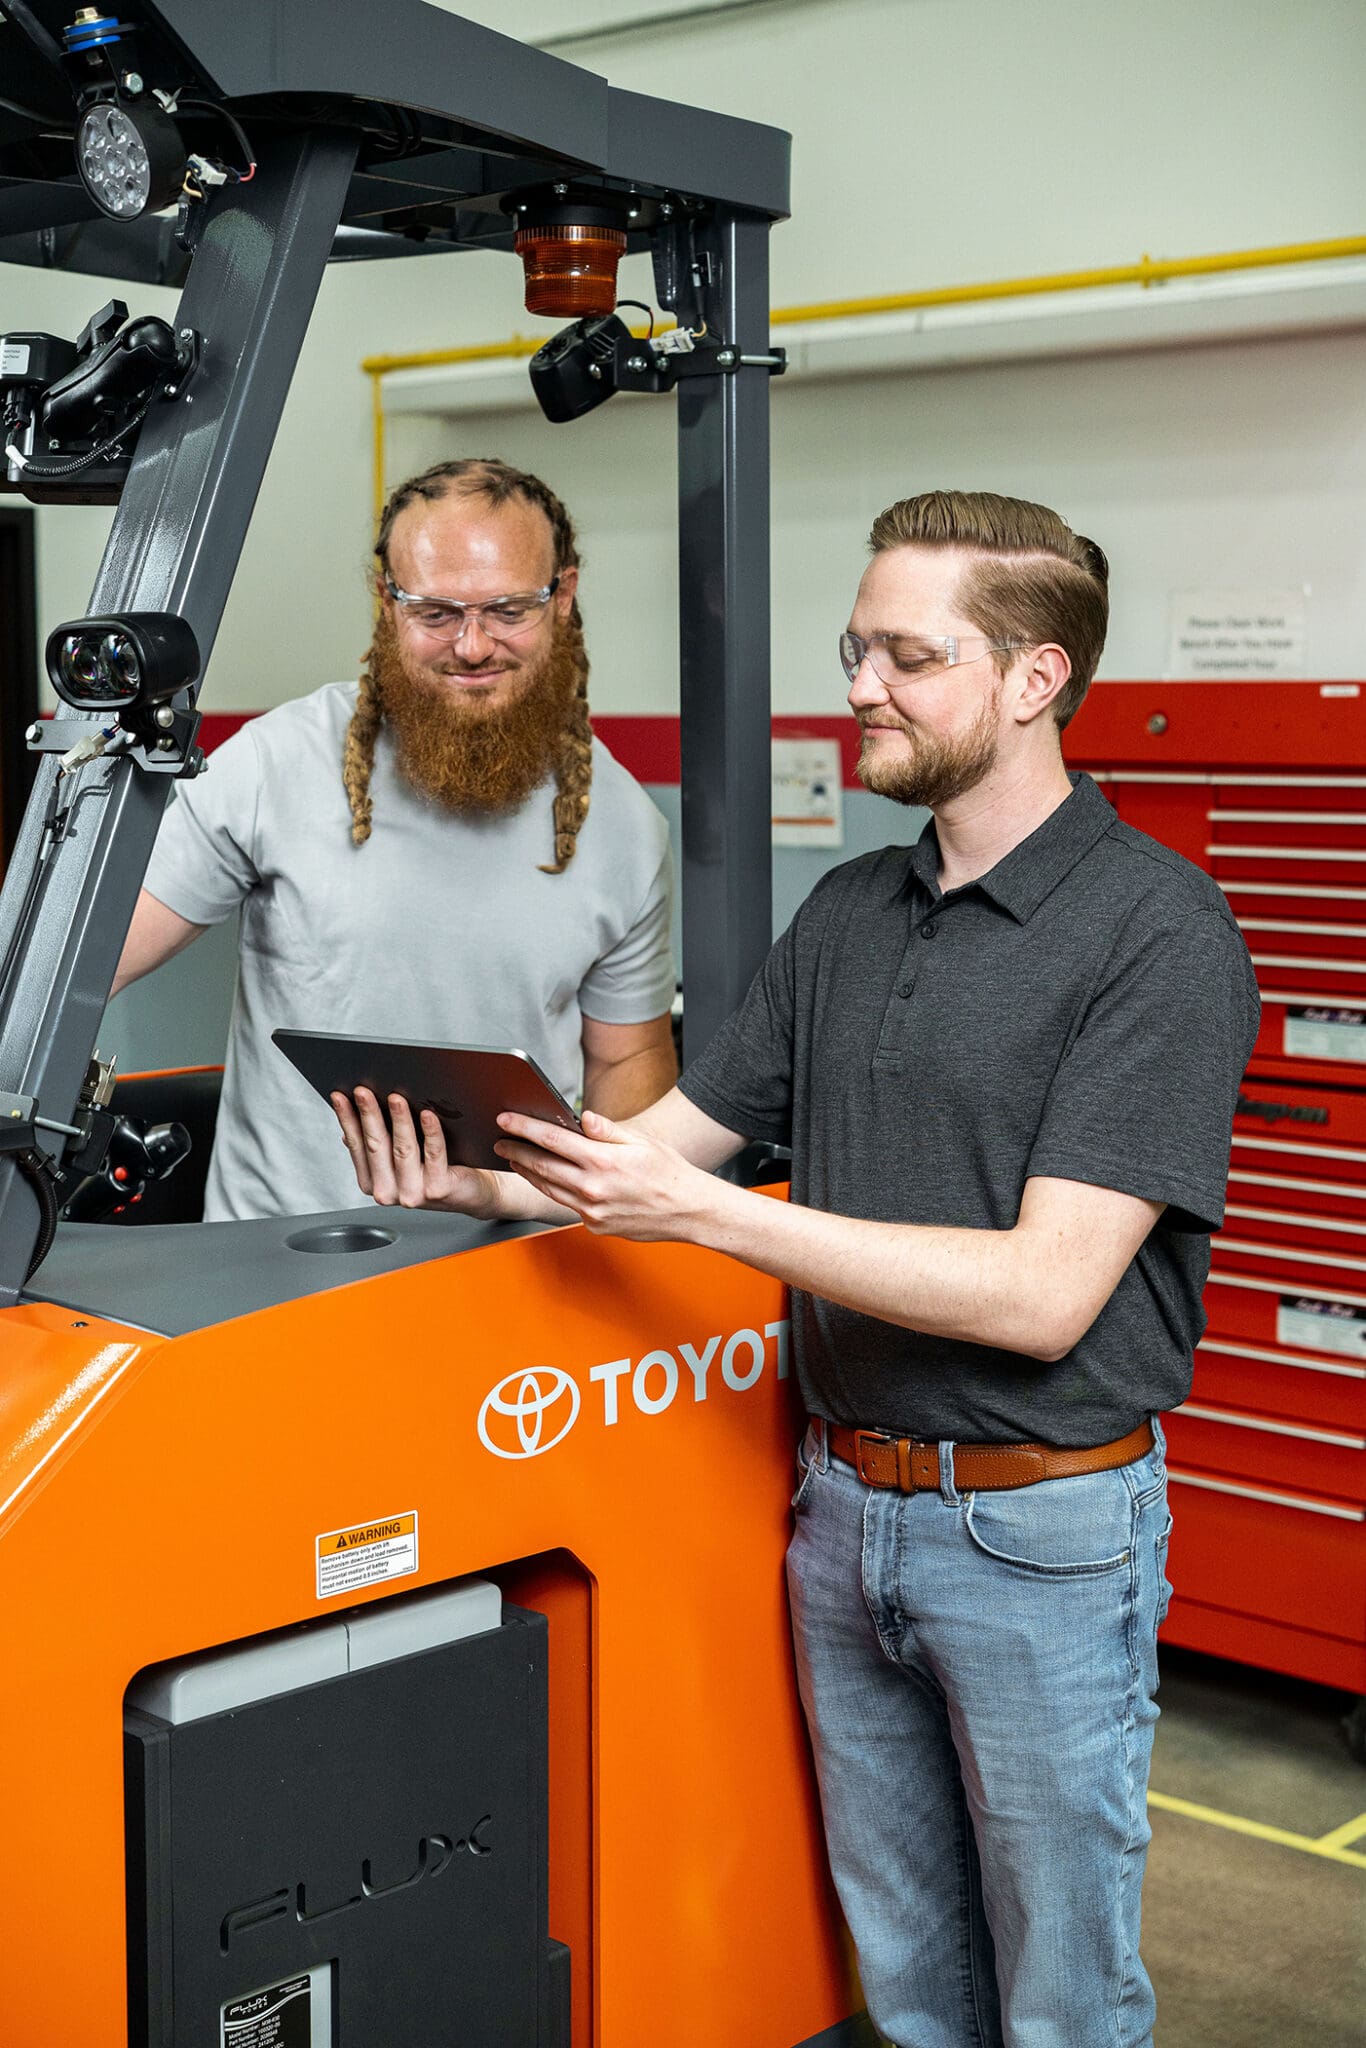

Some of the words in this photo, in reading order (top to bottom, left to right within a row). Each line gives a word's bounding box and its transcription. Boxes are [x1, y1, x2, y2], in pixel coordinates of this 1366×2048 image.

[349, 1522, 400, 1545] WARNING
[321, 1555, 341, 1564] Remove
[342, 1550, 359, 1559] battery
[360, 1546, 370, 1554] only
[321, 1560, 349, 1571] mechanism
[386, 1544, 408, 1554] removed.
[322, 1572, 347, 1582] Horizontal
[348, 1567, 365, 1575] motion
[372, 1561, 388, 1570] battery
[322, 1582, 335, 1590] must
[345, 1575, 363, 1583] exceed
[220, 1814, 491, 1957] FLUX
[230, 1995, 267, 2015] FLUX
[242, 2001, 268, 2015] POWER
